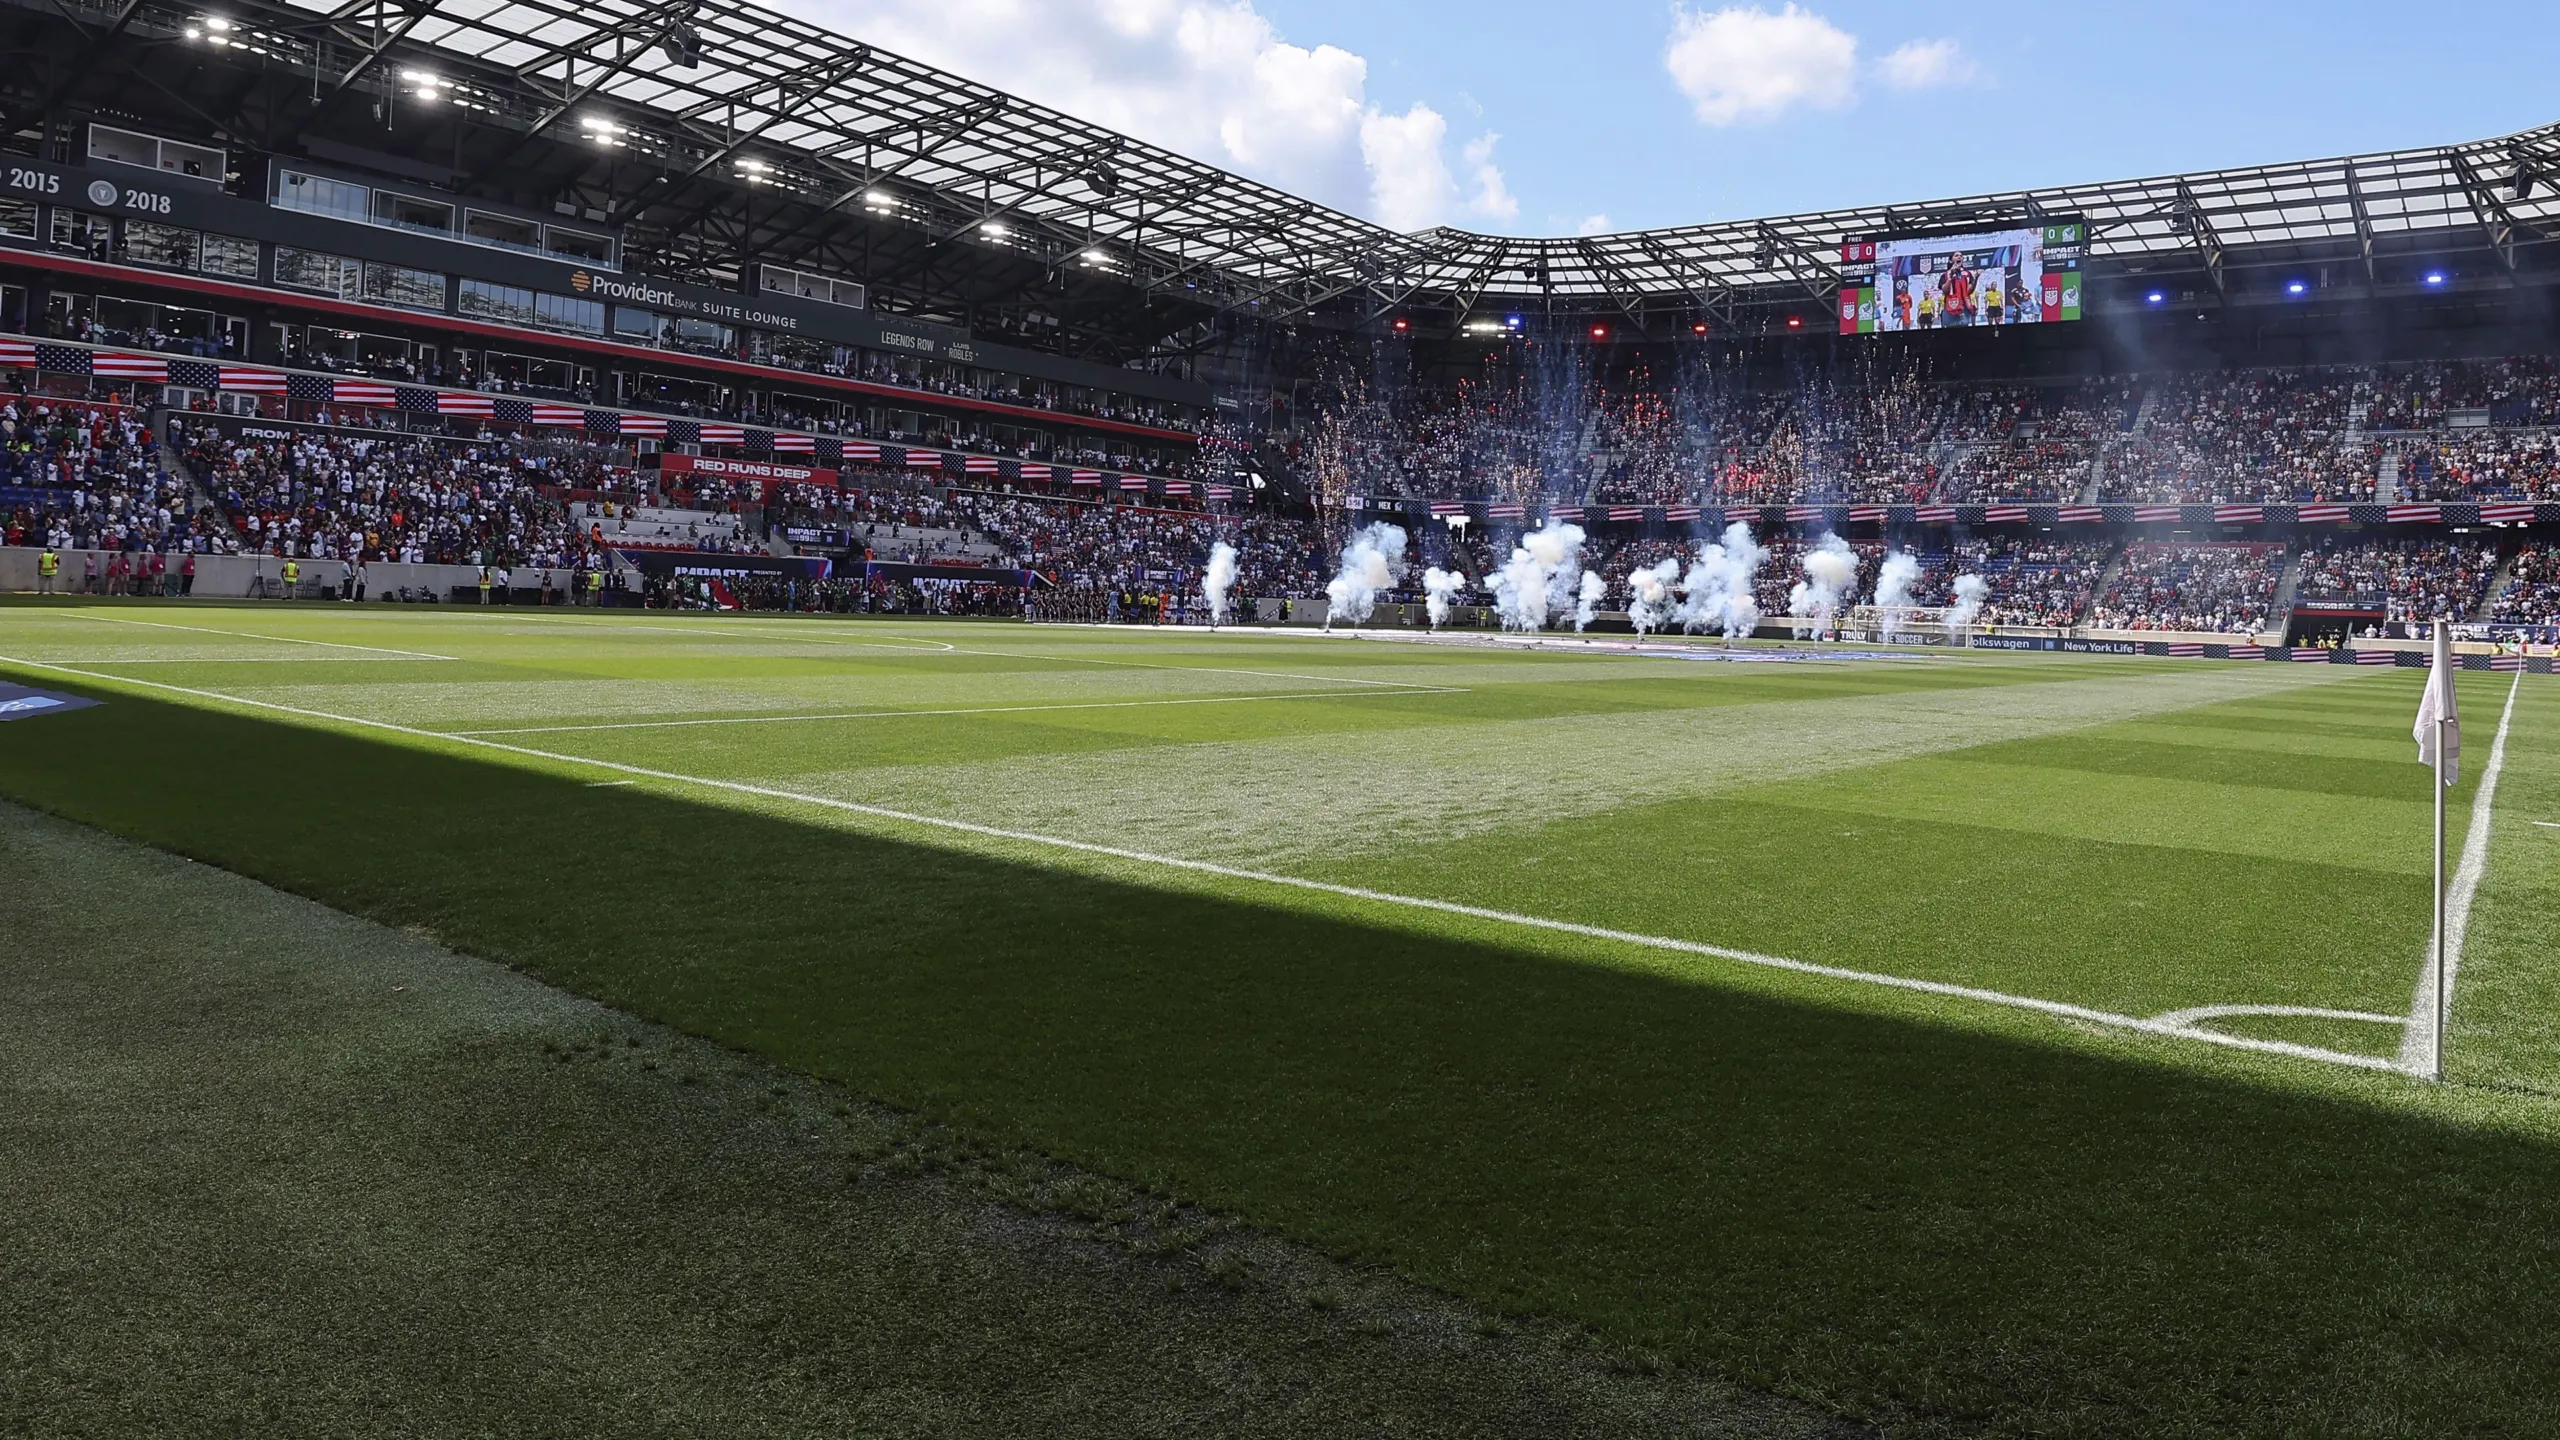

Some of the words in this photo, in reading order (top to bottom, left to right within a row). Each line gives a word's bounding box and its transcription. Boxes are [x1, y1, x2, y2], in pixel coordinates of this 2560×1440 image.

[10, 168, 60, 194] 2015
[125, 189, 171, 214] 2018
[2048, 228, 2056, 239] 0
[1866, 246, 1872, 256] 0
[2042, 246, 2081, 254] IMPACT
[1842, 262, 1876, 272] IMPACT
[592, 275, 675, 307] Provident
[674, 298, 697, 310] BANK
[703, 302, 740, 319] SUITE
[745, 310, 797, 329] LOUNGE
[882, 331, 915, 348] LEGENDS
[917, 338, 934, 352] ROW
[948, 348, 973, 361] ROBLES
[242, 428, 290, 440] FROM
[694, 459, 725, 471] RED
[728, 463, 771, 476] RUNS
[774, 467, 811, 479] DEEP
[1378, 501, 1391, 510] MEX
[788, 528, 821, 536] IMPACT
[1840, 630, 1866, 640] TRULY
[1896, 634, 1923, 644] SOCCER
[2064, 641, 2087, 650] New
[2089, 642, 2111, 652] York
[2113, 642, 2133, 653] Life
